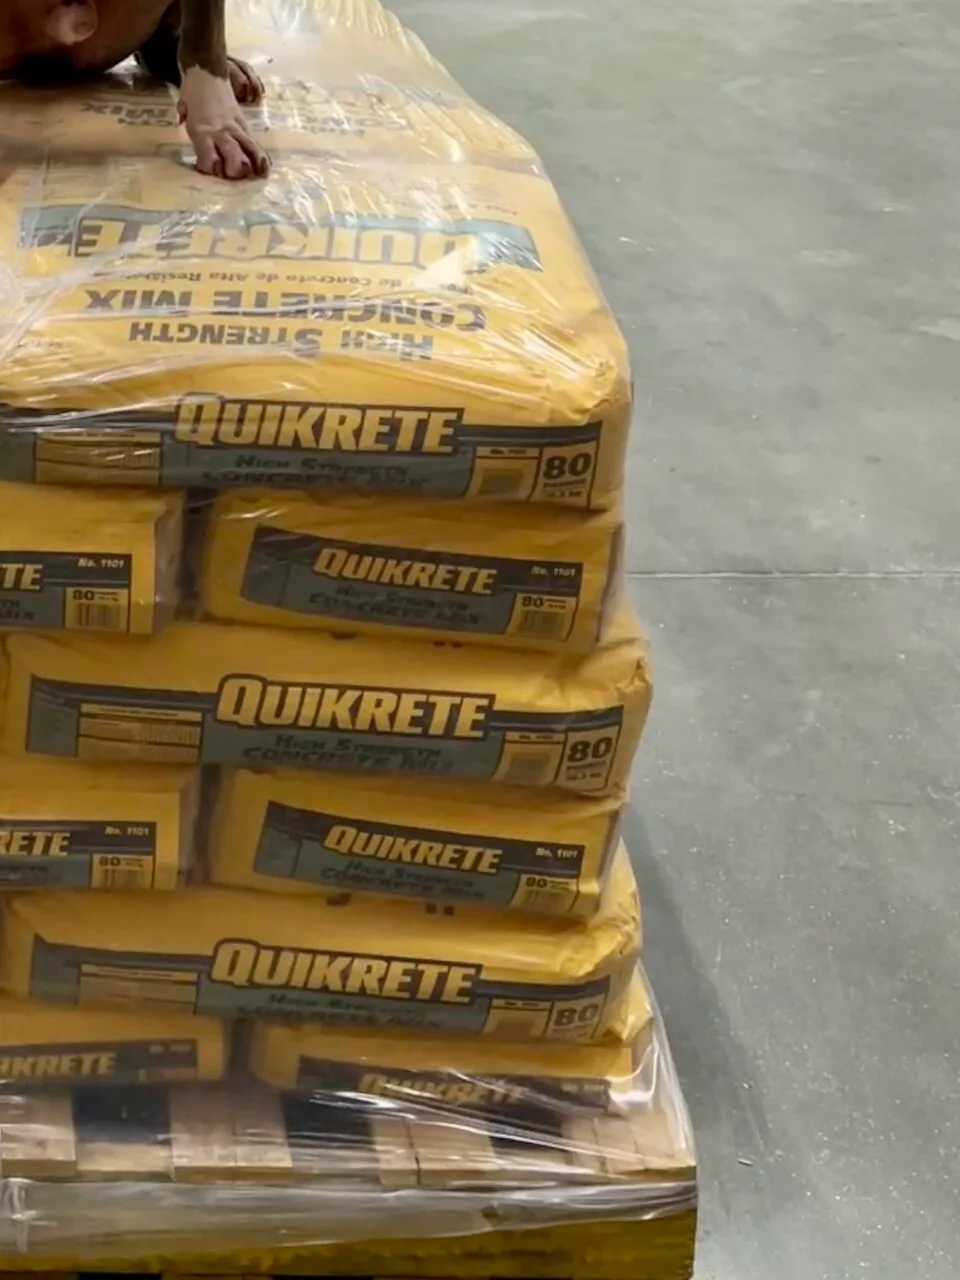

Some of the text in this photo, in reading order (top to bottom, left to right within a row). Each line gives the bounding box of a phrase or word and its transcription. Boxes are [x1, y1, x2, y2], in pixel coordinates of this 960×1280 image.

[84, 289, 485, 332] CONCRETE MIX
[129, 322, 434, 361] HIGH STRENGTH
[174, 396, 460, 454] QUIKRETE
[542, 452, 592, 481] 80
[313, 548, 497, 595] QUIKRETE
[72, 589, 95, 602] 80
[521, 595, 544, 609] 80
[216, 677, 490, 738] QUIKRETE
[568, 737, 613, 763] 80
[98, 856, 121, 868] 80
[322, 824, 502, 874] QUIKRETE
[525, 876, 548, 888] 80
[210, 941, 476, 1003] QUIKRETE
[554, 1003, 600, 1027] 80
